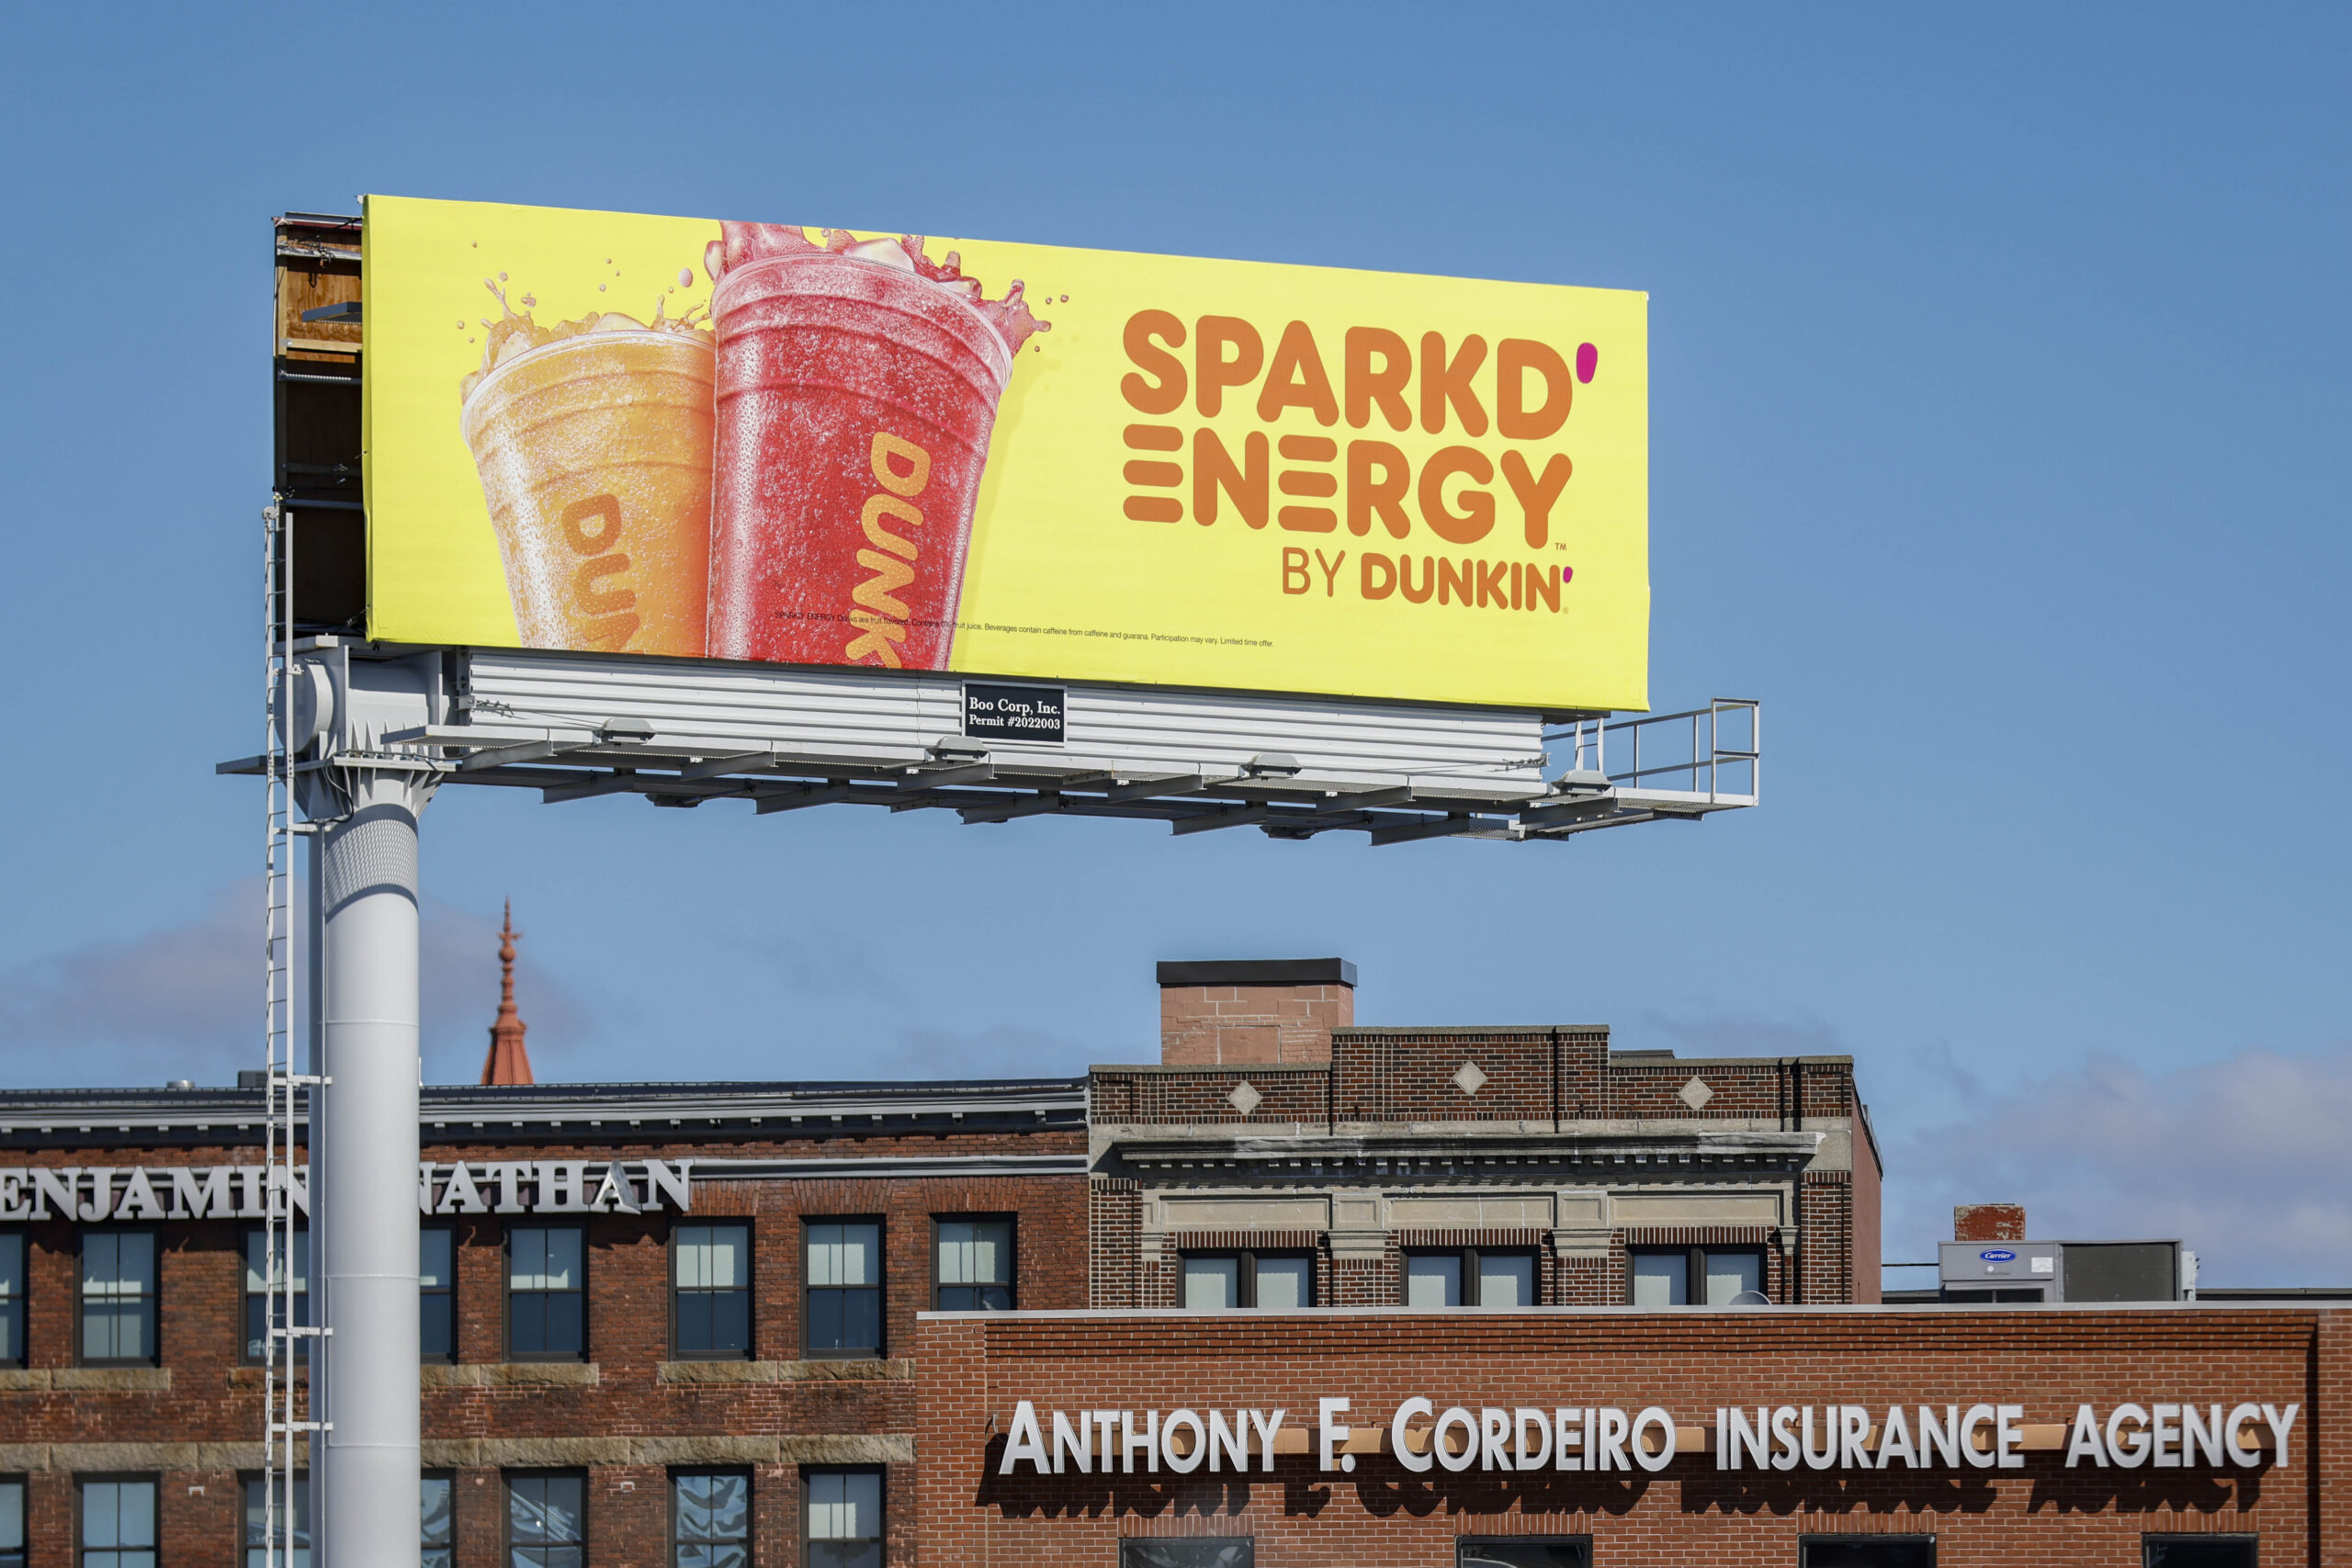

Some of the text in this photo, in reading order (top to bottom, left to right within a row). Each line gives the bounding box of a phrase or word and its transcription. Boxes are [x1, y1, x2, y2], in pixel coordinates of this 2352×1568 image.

[1120, 309, 1599, 441] SPARKD'
[1122, 423, 1573, 549] ENERGY
[1283, 546, 1346, 597] BY
[807, 613, 836, 622] ENERGY
[837, 614, 858, 623] Drinks
[870, 616, 883, 625] fruit
[911, 618, 940, 627] Contains
[967, 623, 983, 632] juice.
[985, 623, 1018, 634] Beverages
[1019, 626, 1042, 635] contain
[1043, 626, 1068, 636] caffeine
[1069, 628, 1083, 637] from
[1084, 629, 1109, 638] caffeine
[1110, 631, 1122, 639] and
[1123, 632, 1150, 641] guarana.
[1151, 633, 1189, 644] Participation
[1191, 636, 1204, 645] may
[1204, 637, 1219, 646] vary.
[1220, 637, 1243, 646] Limited
[1244, 638, 1258, 647] time
[1259, 639, 1274, 648] offer.
[968, 696, 1061, 716] Boo Corp, Inc.
[968, 714, 1061, 729] Permit #2022003
[999, 1395, 2301, 1475] ANTHONY F. CORDEIRO INSURANCE AGENCY
